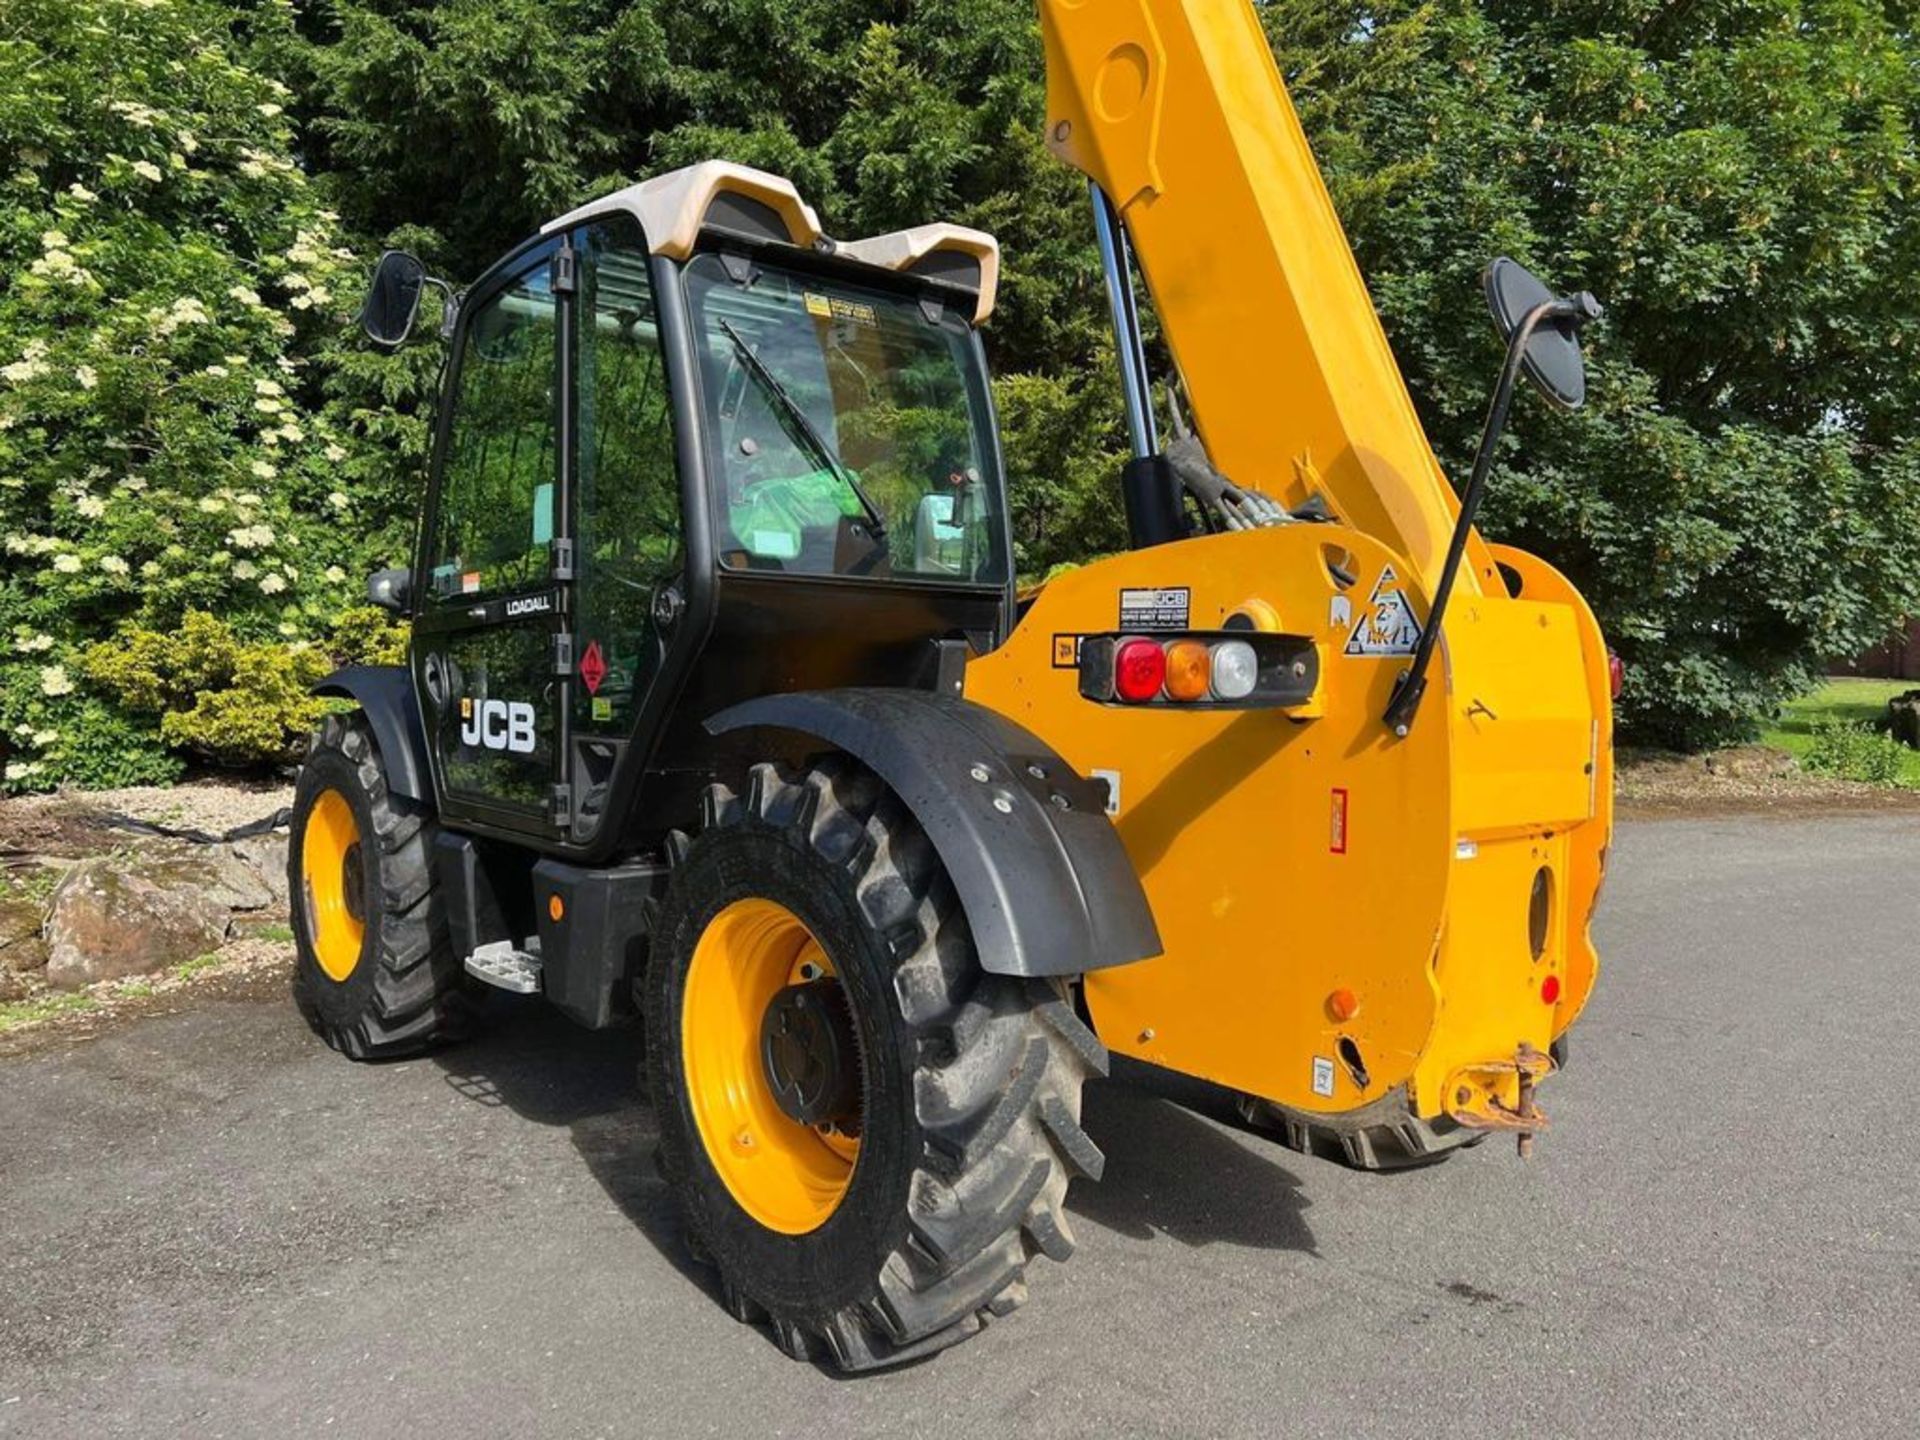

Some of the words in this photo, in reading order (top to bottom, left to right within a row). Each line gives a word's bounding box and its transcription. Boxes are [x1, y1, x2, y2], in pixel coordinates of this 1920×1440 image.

[506, 596, 550, 615] LOADALL
[1155, 592, 1184, 606] JCB
[461, 698, 536, 753] JCB
